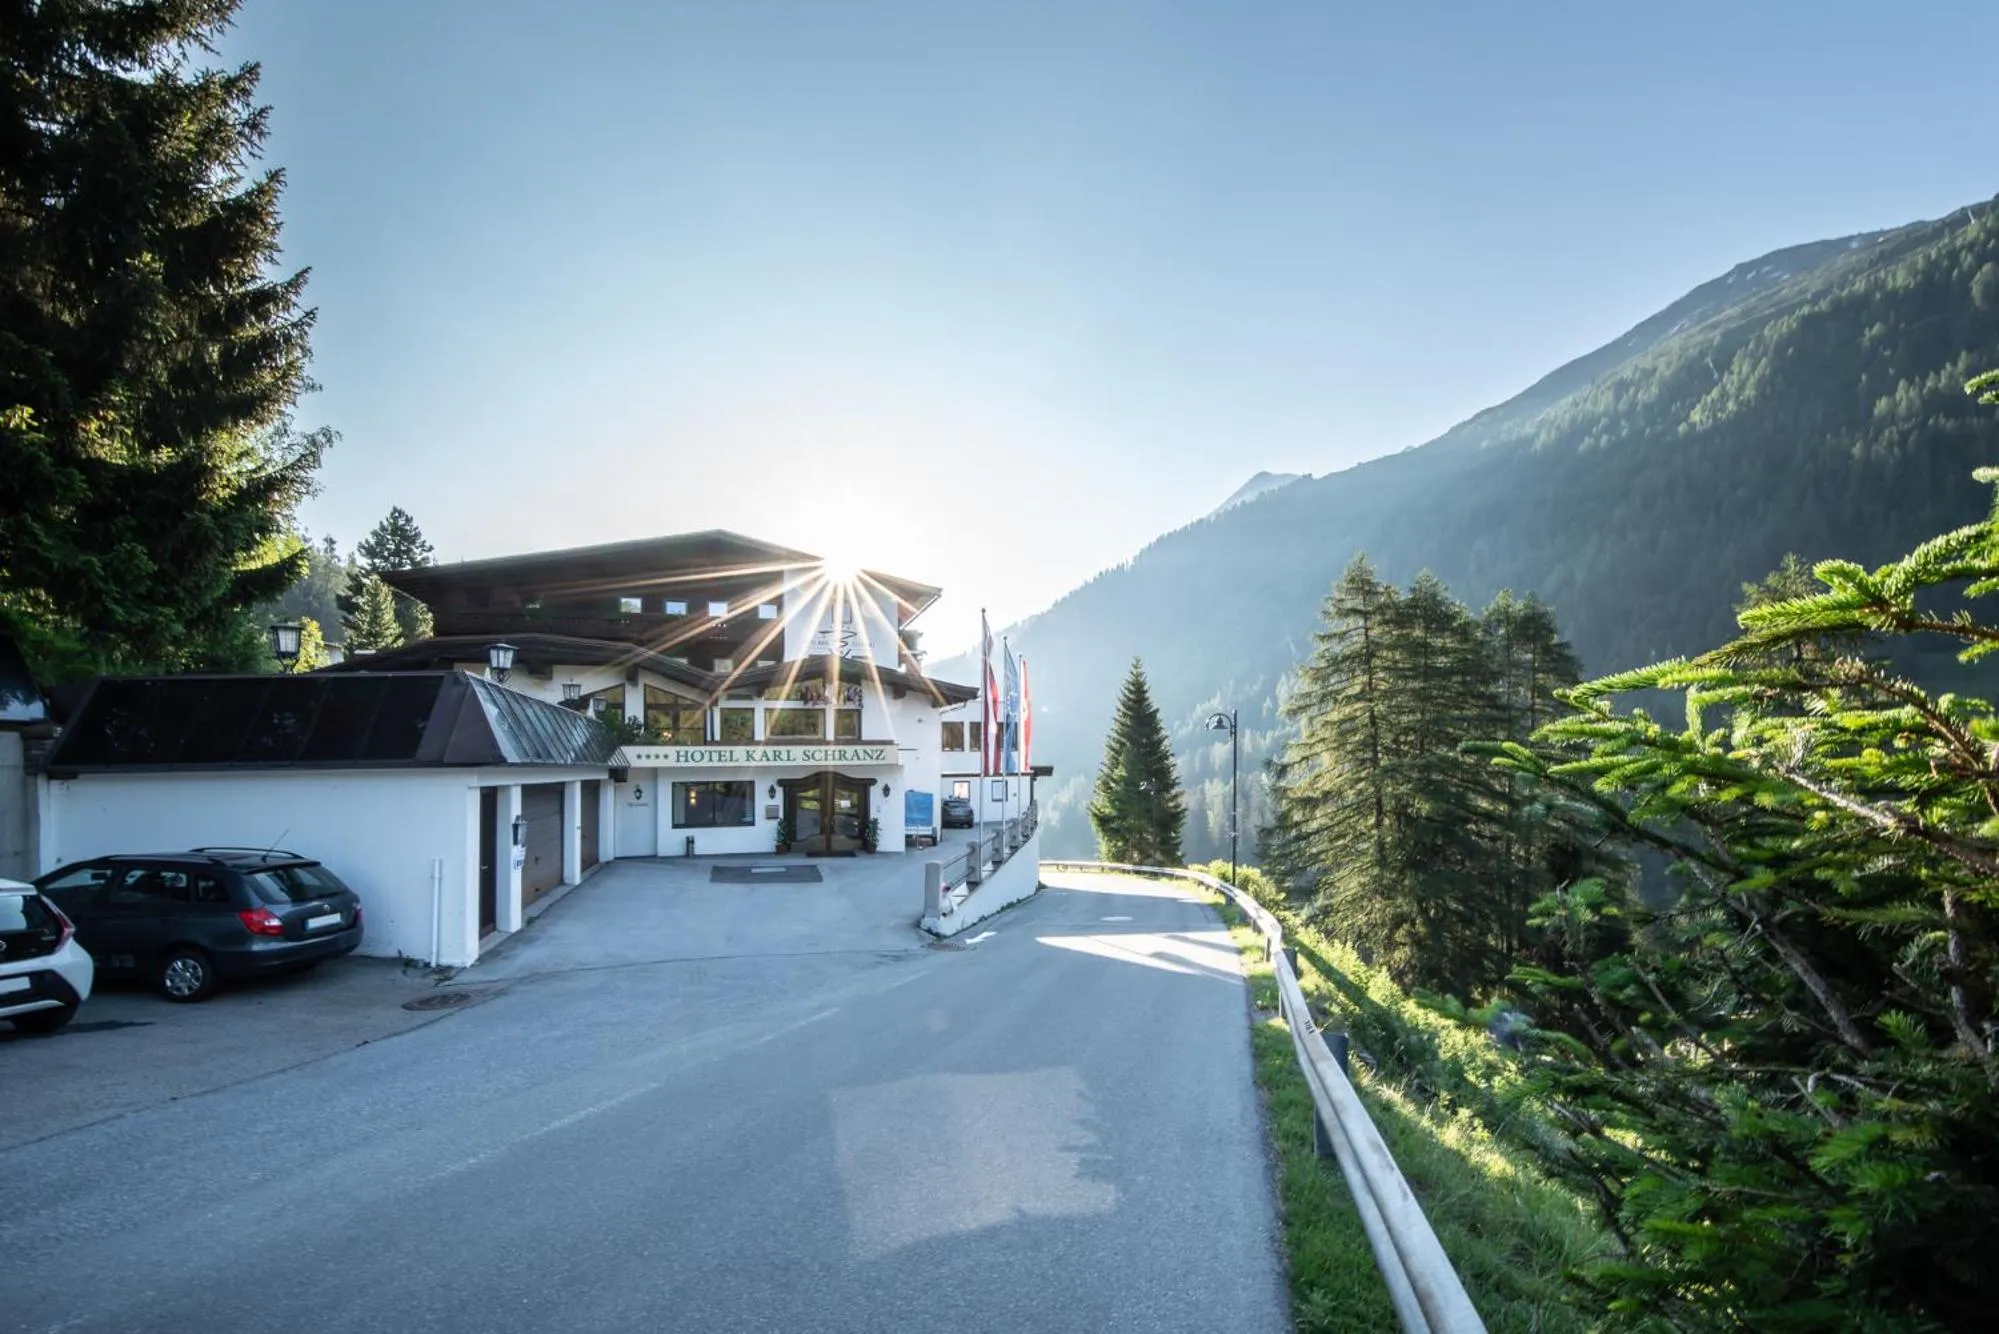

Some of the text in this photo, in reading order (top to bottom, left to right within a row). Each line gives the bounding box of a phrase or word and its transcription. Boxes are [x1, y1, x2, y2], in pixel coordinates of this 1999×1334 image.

[675, 748, 886, 763] HOTEL KARL SCHRANZ
